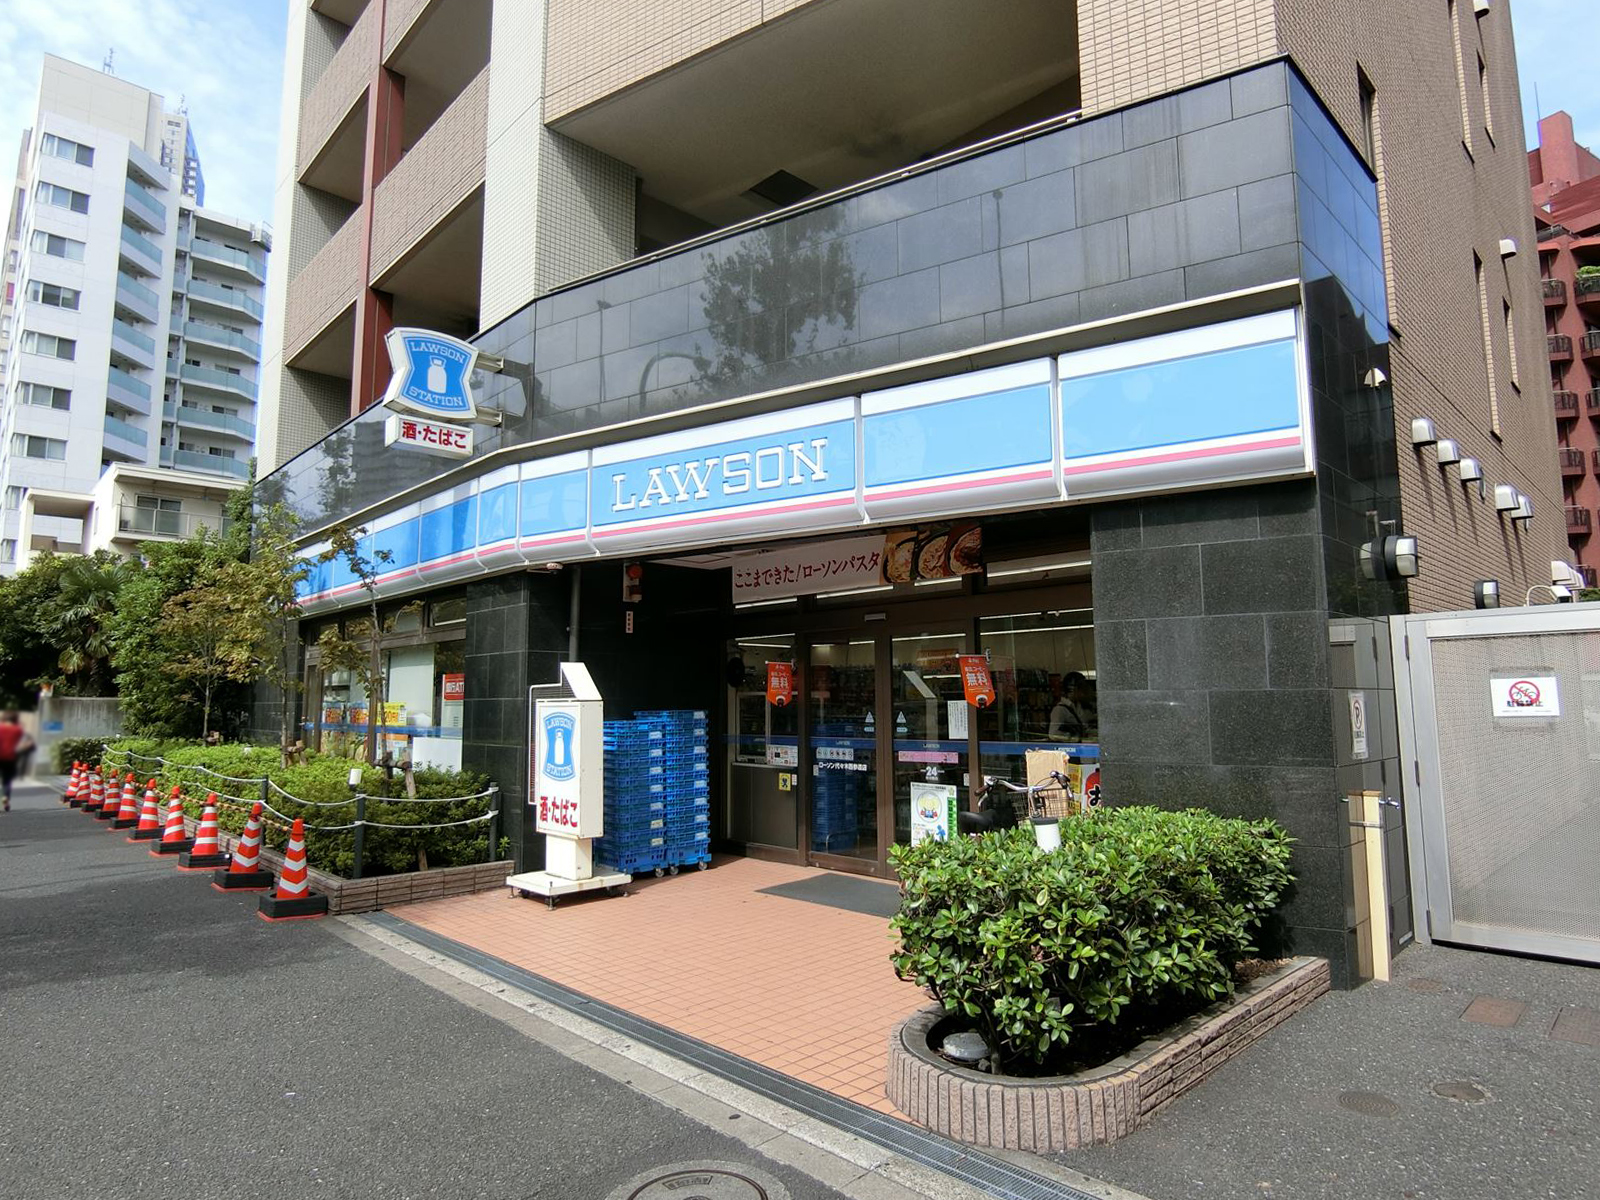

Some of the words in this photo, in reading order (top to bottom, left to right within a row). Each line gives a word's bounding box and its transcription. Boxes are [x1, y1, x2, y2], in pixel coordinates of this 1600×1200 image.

[411, 341, 466, 364] LAWSON
[409, 385, 463, 406] STATION
[402, 421, 466, 449] 酒・たばこ
[612, 437, 828, 513] LAWSON
[546, 718, 573, 731] LAWSON
[546, 762, 573, 778] STATION
[925, 766, 938, 777] 24
[540, 795, 578, 828] 酒・たばこ
